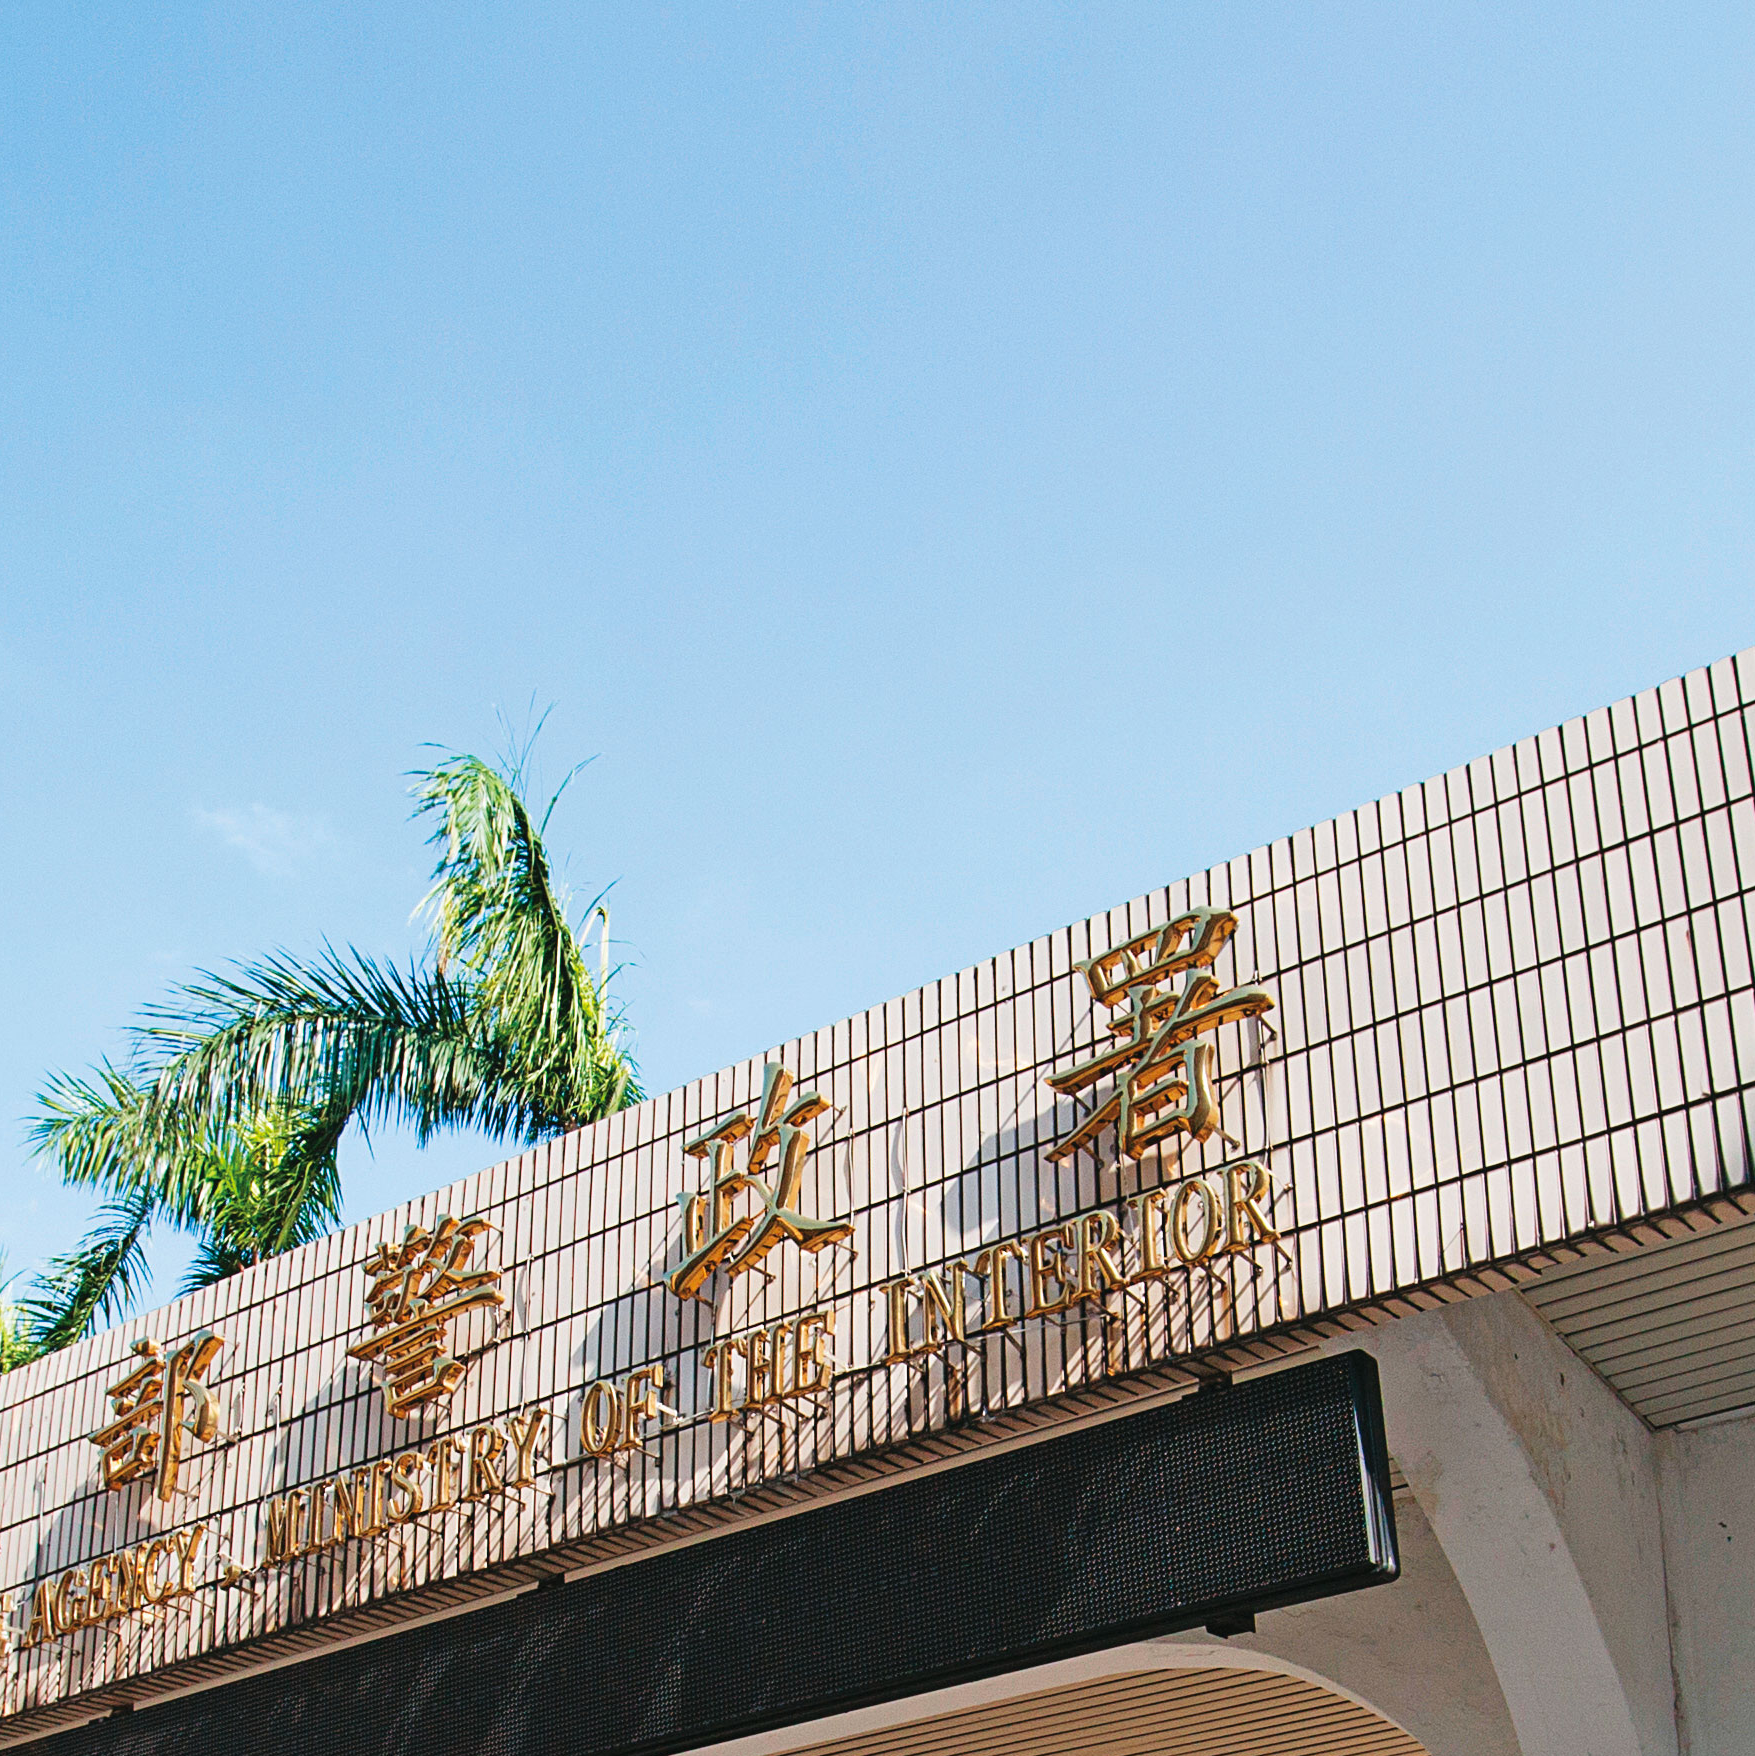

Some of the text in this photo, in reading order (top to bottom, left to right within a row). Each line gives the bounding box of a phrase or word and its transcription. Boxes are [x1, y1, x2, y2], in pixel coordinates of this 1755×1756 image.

[264, 1407, 548, 1569] MINISTRY
[580, 1365, 664, 1458] OF
[702, 1309, 835, 1423] THE
[879, 1160, 1282, 1364] INTERIOR
